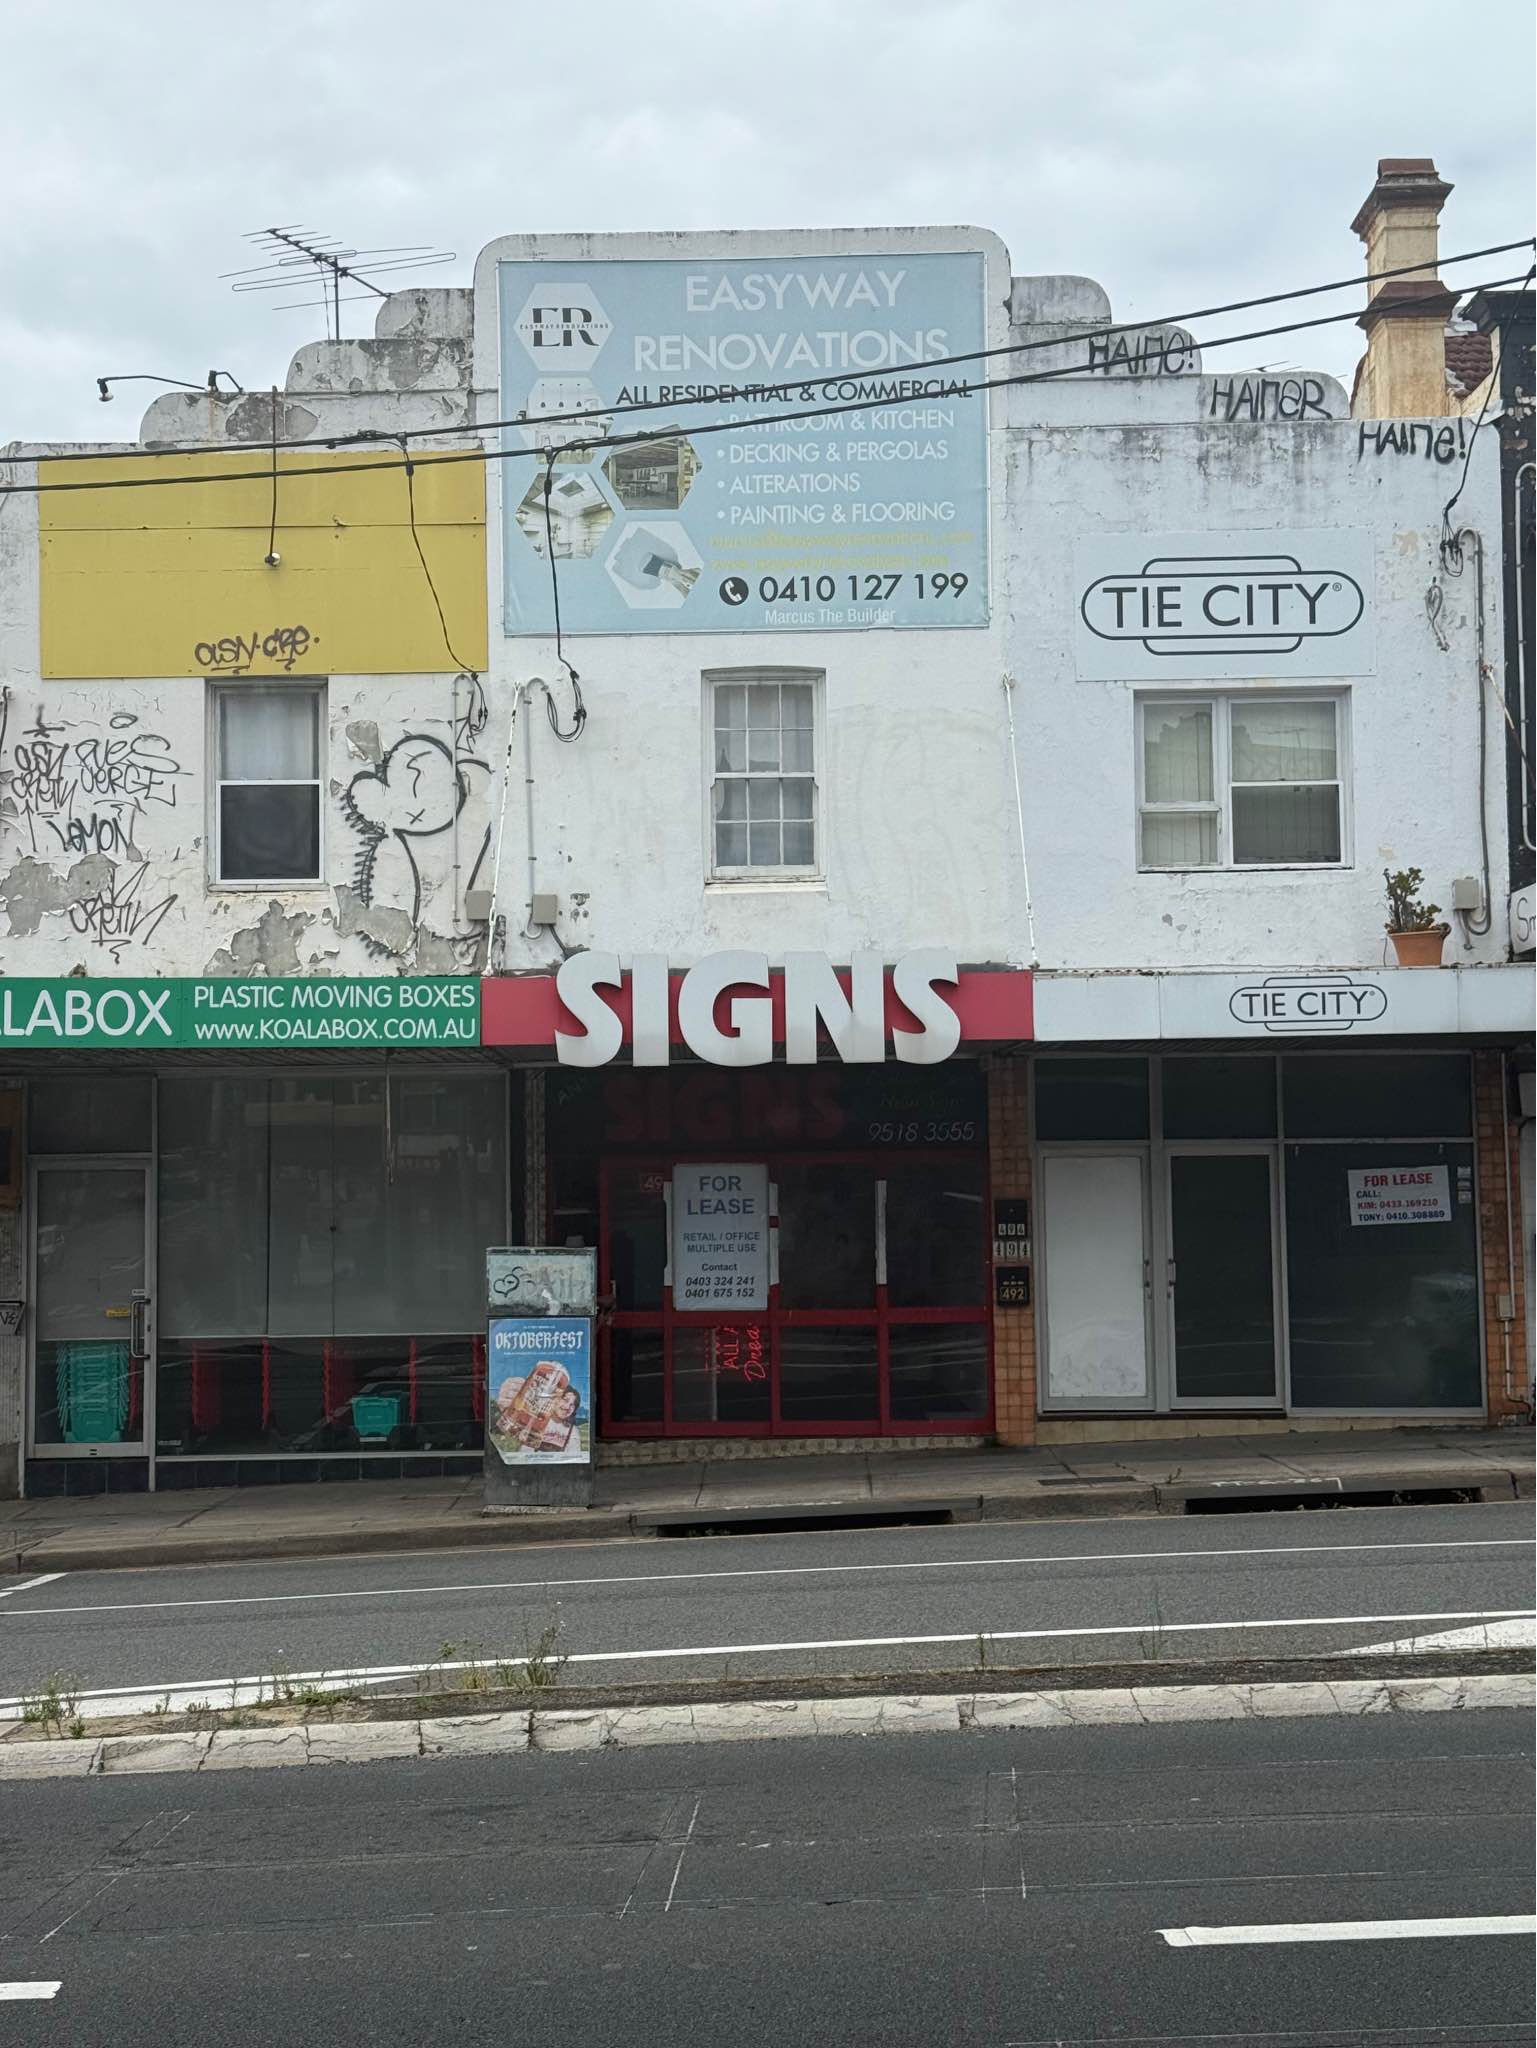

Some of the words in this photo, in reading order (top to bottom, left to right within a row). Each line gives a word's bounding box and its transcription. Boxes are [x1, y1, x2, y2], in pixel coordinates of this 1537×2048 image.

[686, 270, 906, 312] EASYWAY
[634, 328, 950, 372] RENOVATIONS
[616, 385, 652, 405] ALL
[659, 383, 793, 404] RESIDENTIAL
[799, 383, 816, 402] &
[822, 379, 973, 401] COMMERCIAL
[851, 410, 865, 431] &
[871, 409, 955, 430] KITCHEN
[730, 444, 819, 464] DECKING
[827, 443, 842, 463] &
[847, 440, 948, 462] PERGOLAS
[729, 472, 861, 495] ALTERATIONS
[730, 504, 827, 525] PAINTING
[832, 503, 847, 524] &
[852, 501, 956, 523] FLOORING
[759, 575, 836, 603] 0410
[848, 574, 903, 601] 127
[914, 572, 969, 599] 199
[765, 609, 815, 625] Marcus
[817, 608, 844, 624] The
[848, 607, 896, 624] Builder
[1102, 585, 1183, 628] TIE
[0, 989, 173, 1037] LABOX
[194, 985, 285, 1009] PLASTIC
[292, 985, 392, 1009] MOVING
[400, 985, 475, 1009] BOXES
[554, 946, 961, 1067] SIGNS
[1240, 992, 1286, 1017] TIE
[869, 1121, 920, 1142] 9518
[923, 1120, 977, 1142] 3555
[699, 1175, 742, 1192] FOR
[1363, 1175, 1389, 1187] FOR
[1392, 1172, 1433, 1185] LEASE
[688, 1198, 754, 1215] LEASE
[683, 1232, 717, 1242] RETAIL
[725, 1232, 760, 1241] OFFICE
[687, 1243, 735, 1254] MULTIPLE
[737, 1243, 758, 1253] USE
[701, 1262, 738, 1272] Contact
[686, 1276, 711, 1287] 0403
[713, 1276, 734, 1287] 324
[736, 1276, 755, 1286] 241
[685, 1288, 710, 1299] 0401
[1002, 1288, 1025, 1300] 492
